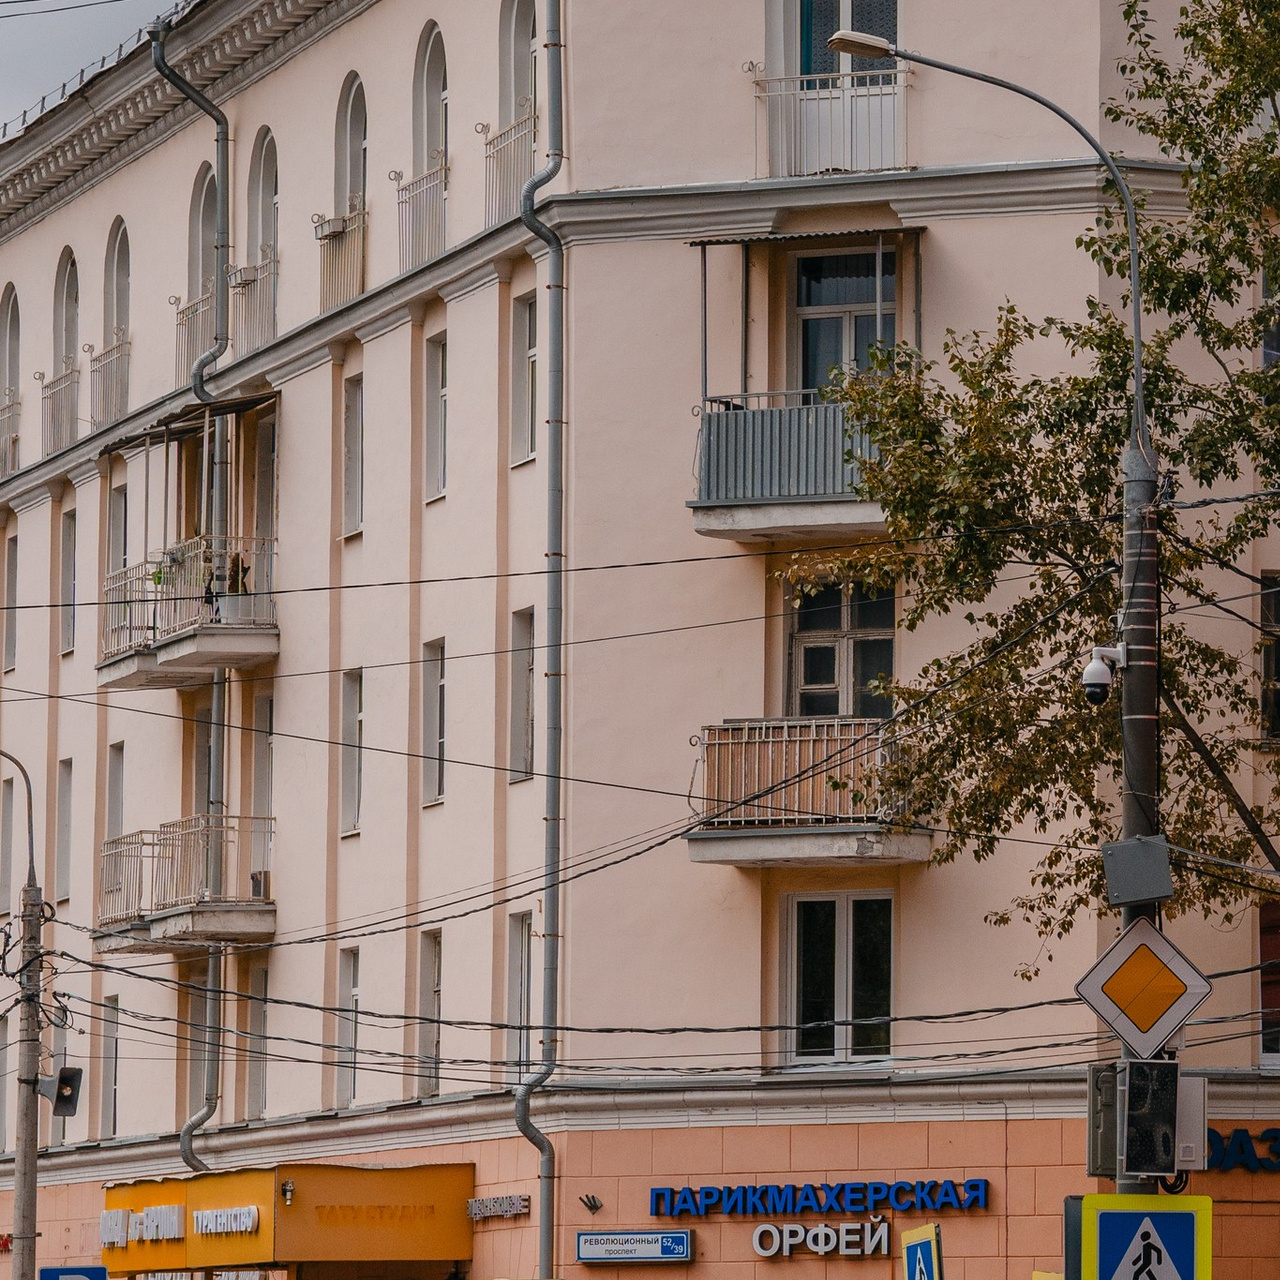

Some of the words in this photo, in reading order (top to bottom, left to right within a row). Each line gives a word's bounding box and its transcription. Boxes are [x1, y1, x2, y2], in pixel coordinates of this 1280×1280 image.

[650, 1179, 989, 1217] ПАРИКМАХЕРСКАЯ
[193, 1205, 258, 1234] ТУРАГЕНТСТВО
[584, 1237, 660, 1246] РЕВОЛЮЦИОННЫЙ
[662, 1237, 684, 1254] 52/39
[752, 1215, 889, 1258] ОРФЕЙ
